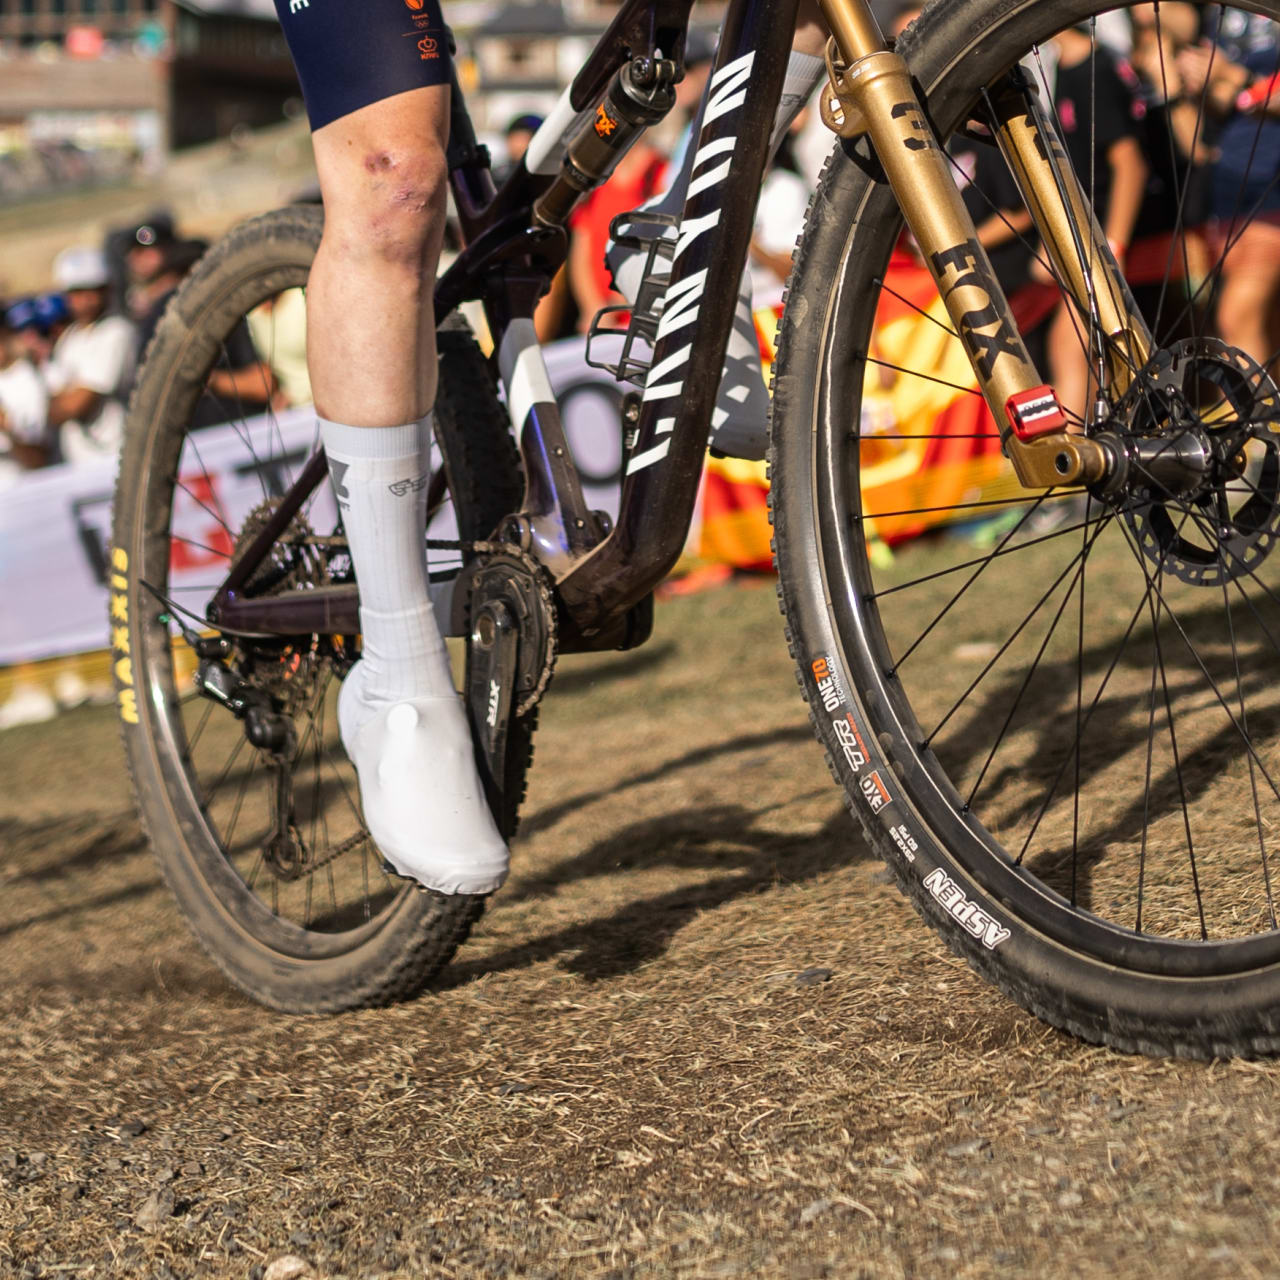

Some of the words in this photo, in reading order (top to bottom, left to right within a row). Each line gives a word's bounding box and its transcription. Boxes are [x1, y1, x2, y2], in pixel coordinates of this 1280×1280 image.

[626, 50, 756, 477] CANYON
[930, 238, 1027, 381] FOX
[110, 547, 140, 724] MAXXIS
[486, 679, 501, 727] XTR
[861, 775, 884, 811] EXO
[898, 823, 912, 841] PSI
[923, 867, 1011, 951] ASPEN
